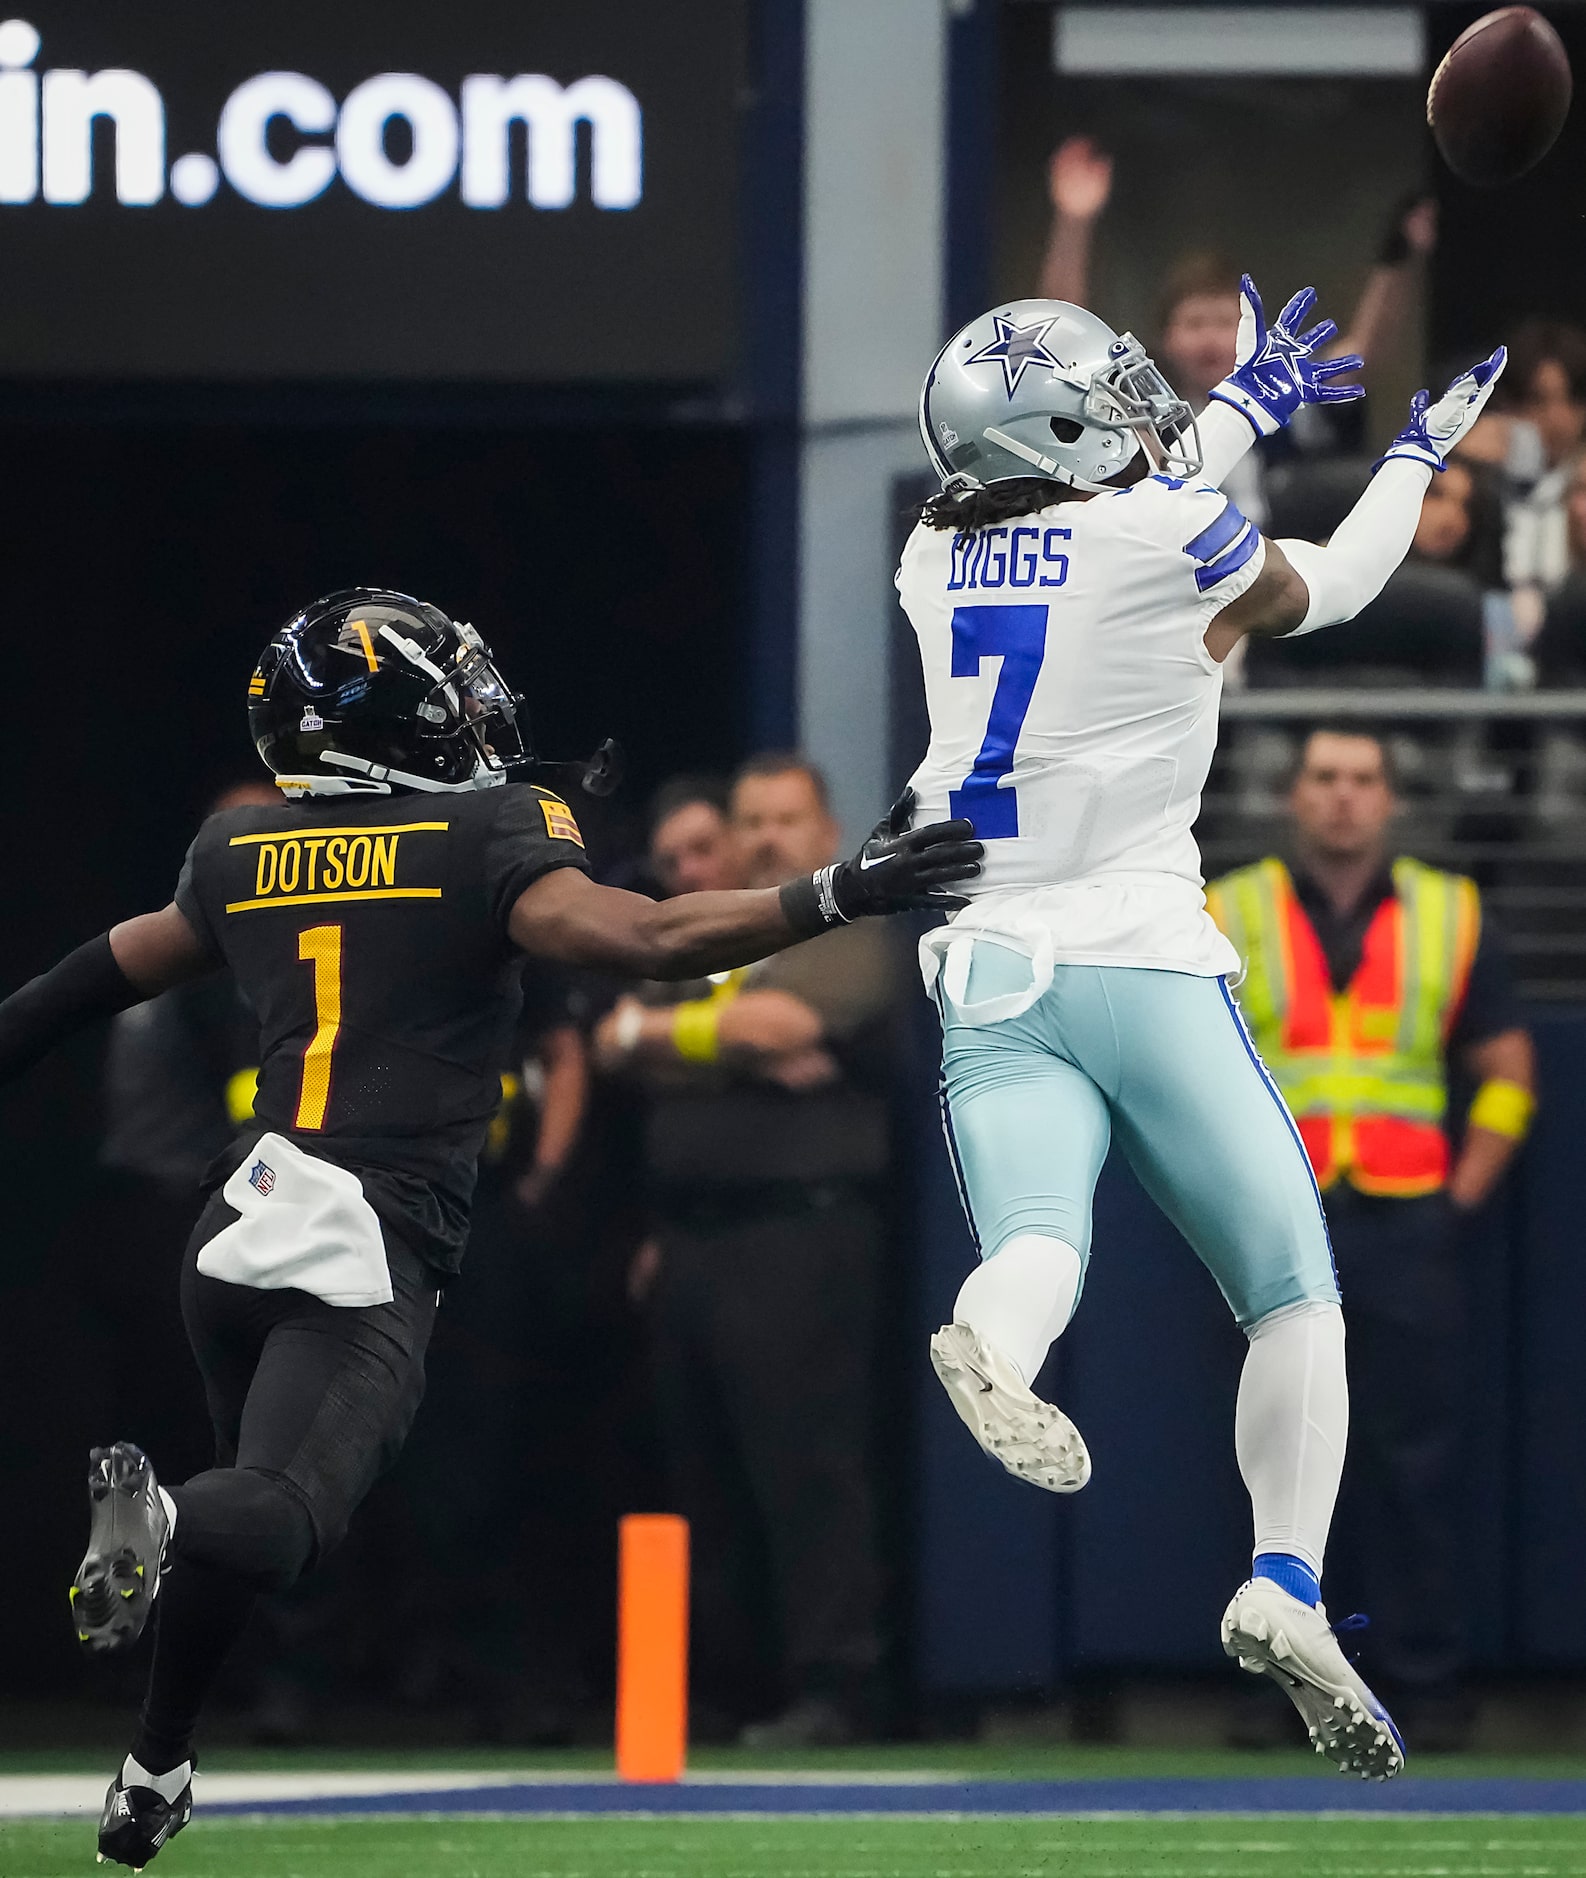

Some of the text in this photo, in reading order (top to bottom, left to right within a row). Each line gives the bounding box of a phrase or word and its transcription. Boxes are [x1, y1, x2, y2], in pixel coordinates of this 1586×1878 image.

[0, 19, 642, 208] in.com
[947, 527, 1072, 591] DIGGS
[351, 620, 379, 673] 1
[949, 604, 1050, 840] 7
[256, 834, 399, 896] DOTSON
[294, 924, 342, 1130] 1
[257, 1171, 274, 1194] NFL
